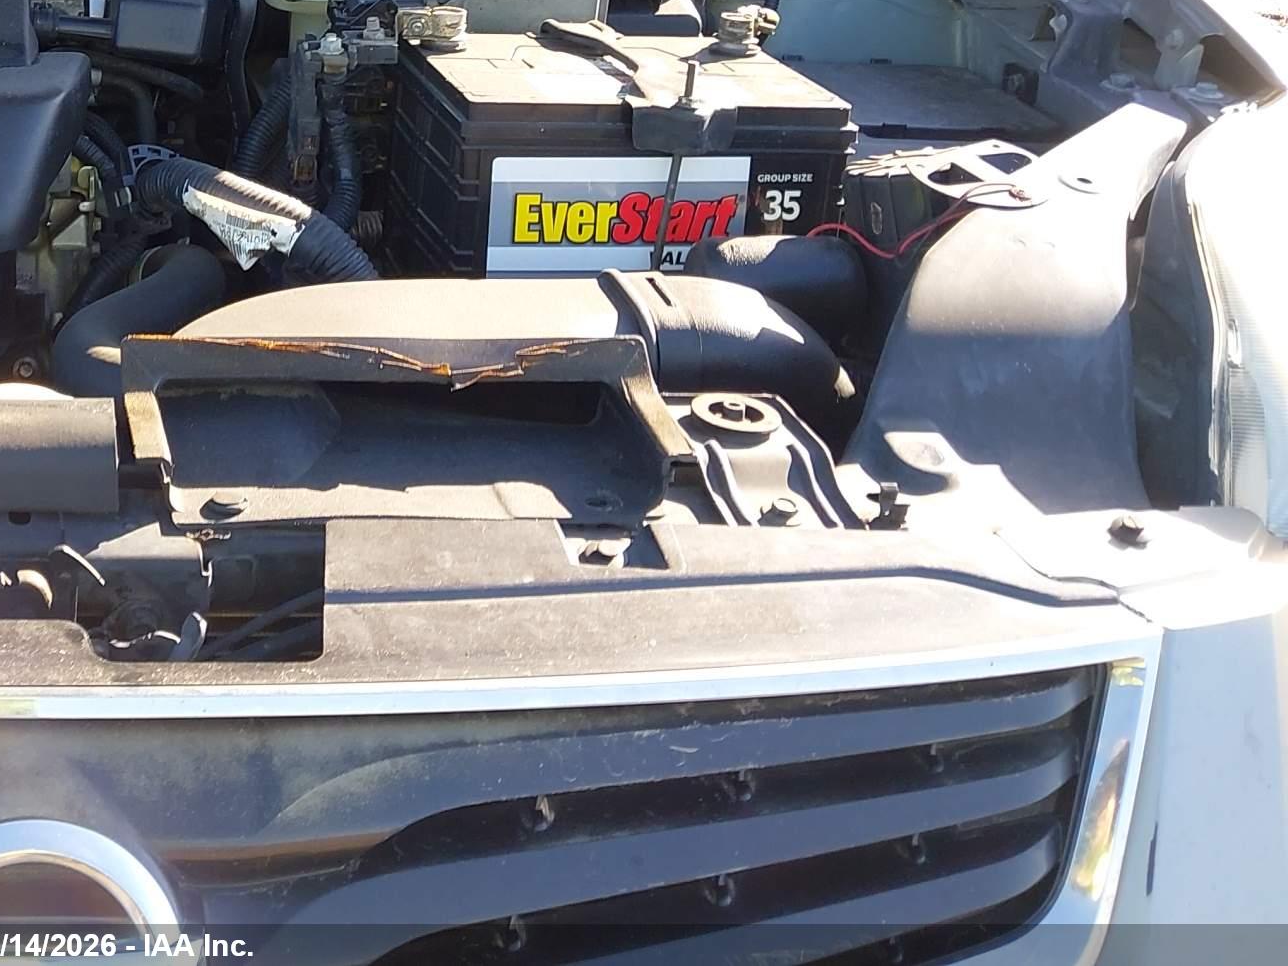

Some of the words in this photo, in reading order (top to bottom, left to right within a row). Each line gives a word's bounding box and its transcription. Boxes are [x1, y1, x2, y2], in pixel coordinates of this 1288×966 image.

[757, 173, 791, 183] GROUP
[792, 173, 813, 182] SIZE
[513, 192, 739, 243] EverStart
[763, 189, 802, 221] 35
